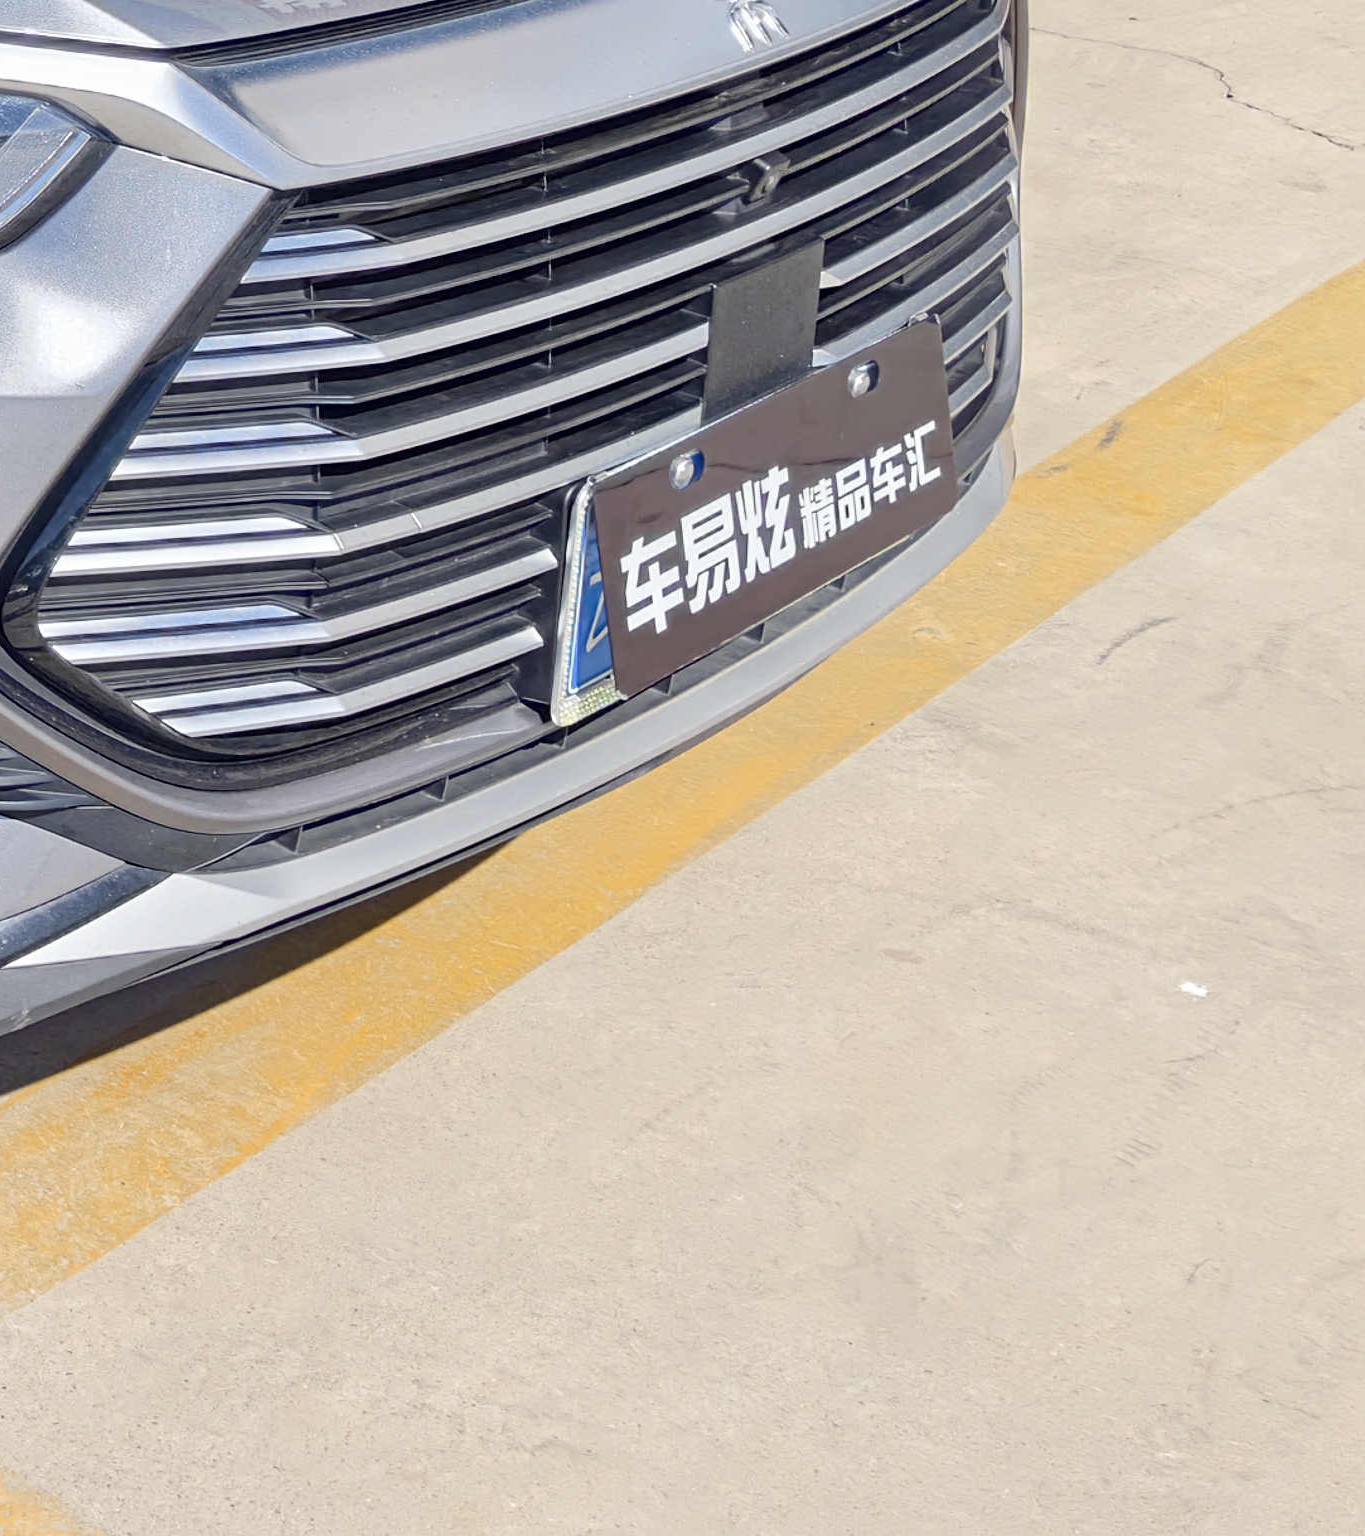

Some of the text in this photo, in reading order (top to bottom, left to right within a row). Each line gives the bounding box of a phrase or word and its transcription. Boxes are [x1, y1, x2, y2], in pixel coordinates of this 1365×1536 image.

[619, 465, 797, 635] 车易炫
[797, 419, 942, 550] 精品车汇
